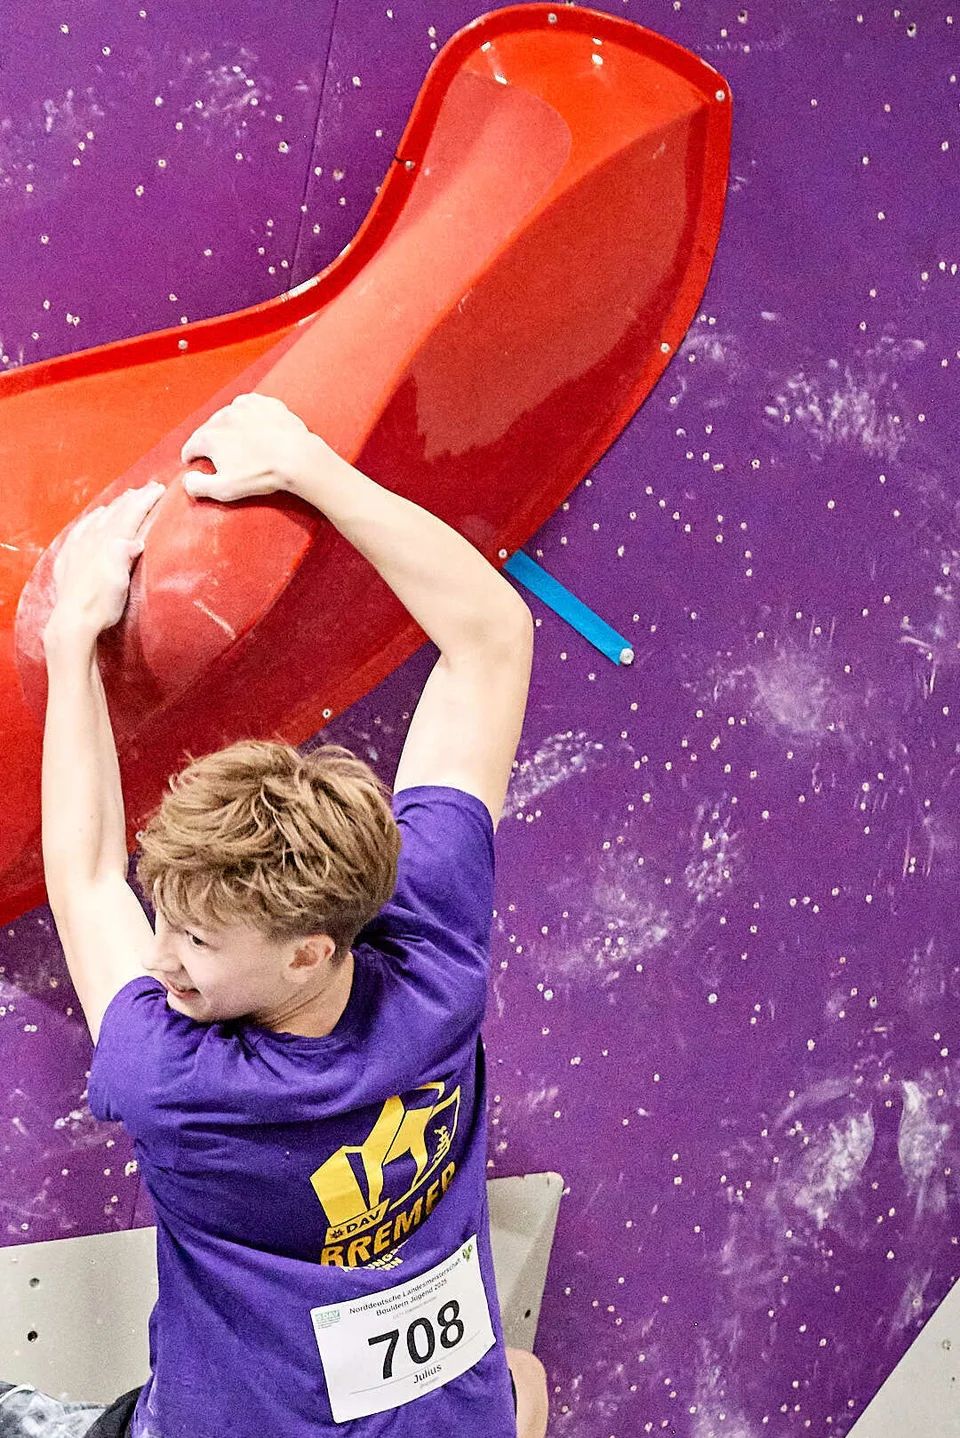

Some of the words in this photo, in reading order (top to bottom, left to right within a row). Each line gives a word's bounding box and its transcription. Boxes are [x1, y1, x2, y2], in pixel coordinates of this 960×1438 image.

[346, 1208, 381, 1234] DAV
[349, 1293, 402, 1315] Norddeutsche
[376, 1299, 410, 1317] Bouldern
[410, 1285, 435, 1304] Jugend
[367, 1299, 465, 1380] 708
[413, 1363, 443, 1385] Julius
